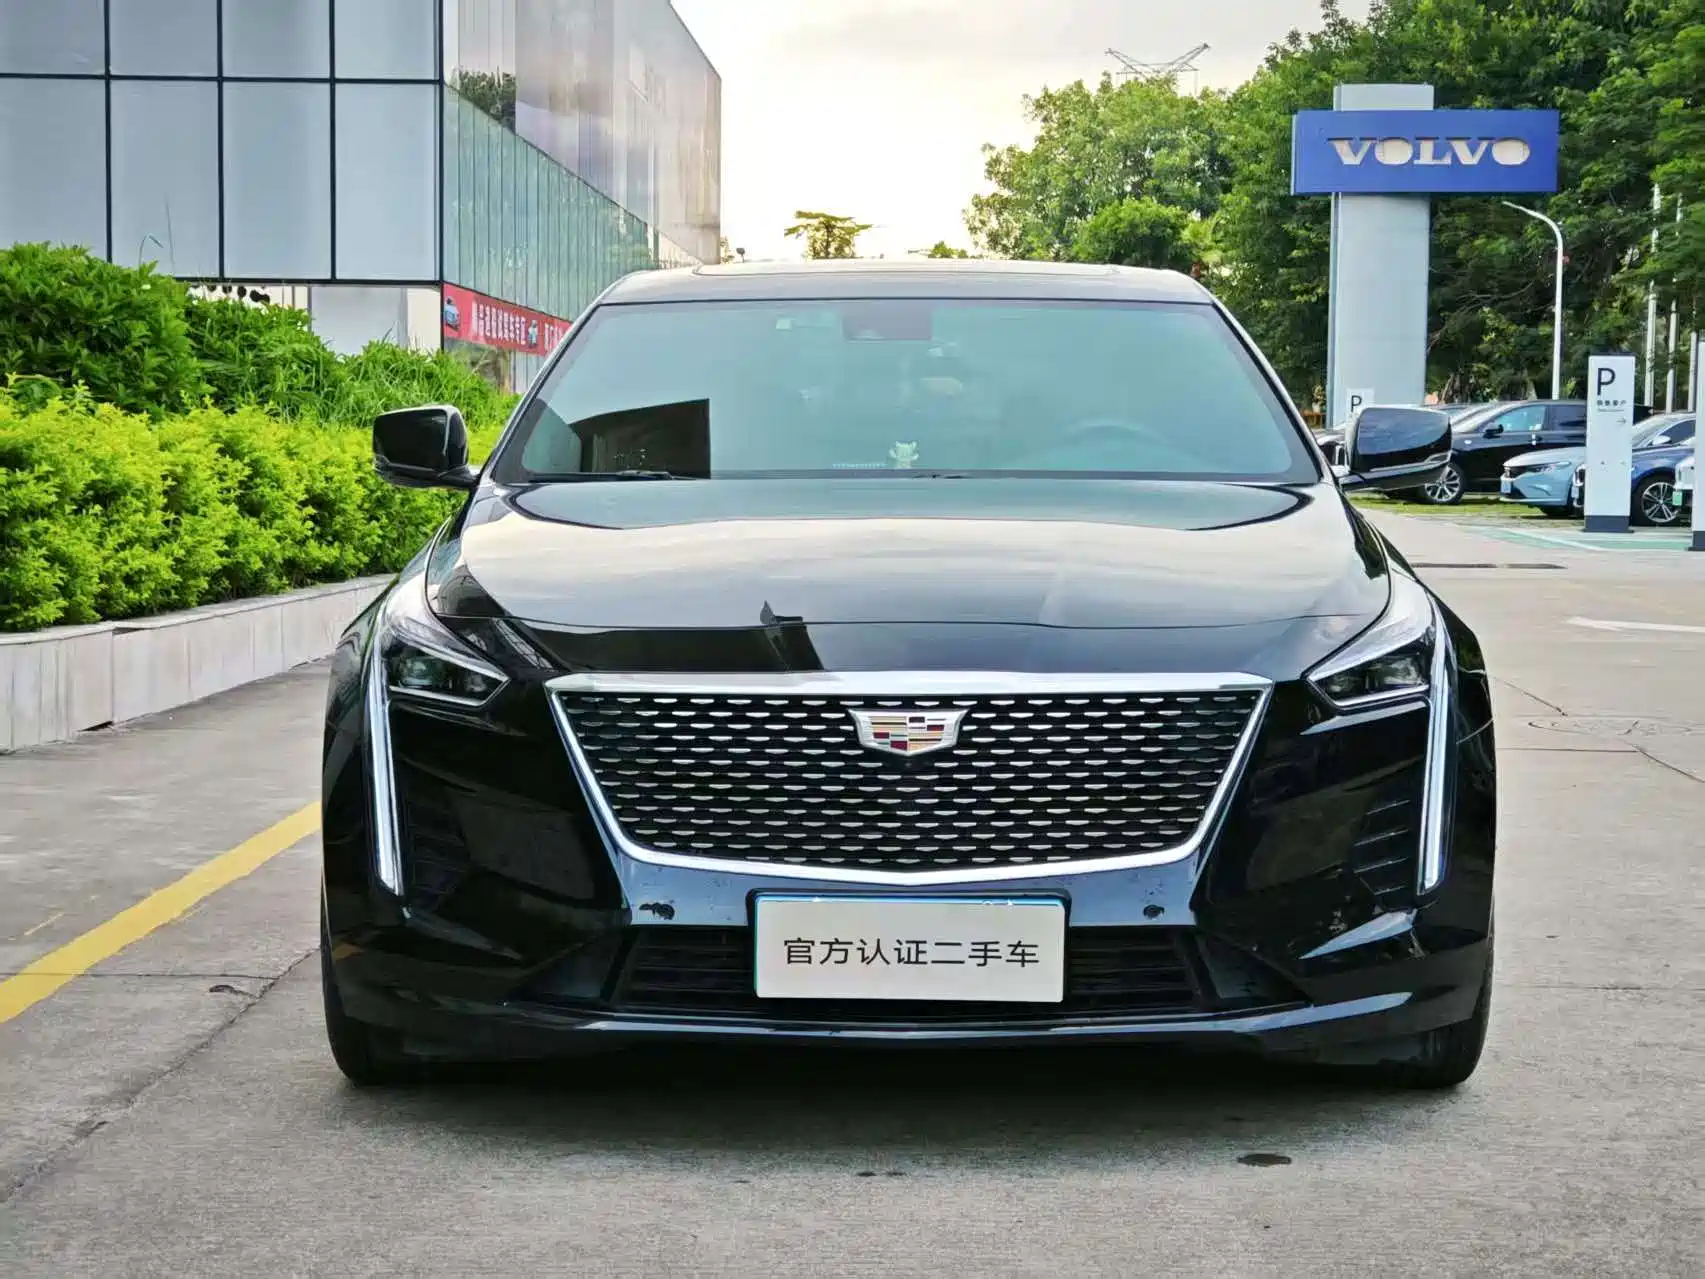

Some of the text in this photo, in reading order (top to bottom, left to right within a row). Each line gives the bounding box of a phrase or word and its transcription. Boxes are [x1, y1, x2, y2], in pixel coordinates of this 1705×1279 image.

[1327, 137, 1531, 166] VOLVO
[1597, 367, 1616, 396] P
[1351, 394, 1363, 412] P
[783, 937, 1040, 968] 官方认证二手车
